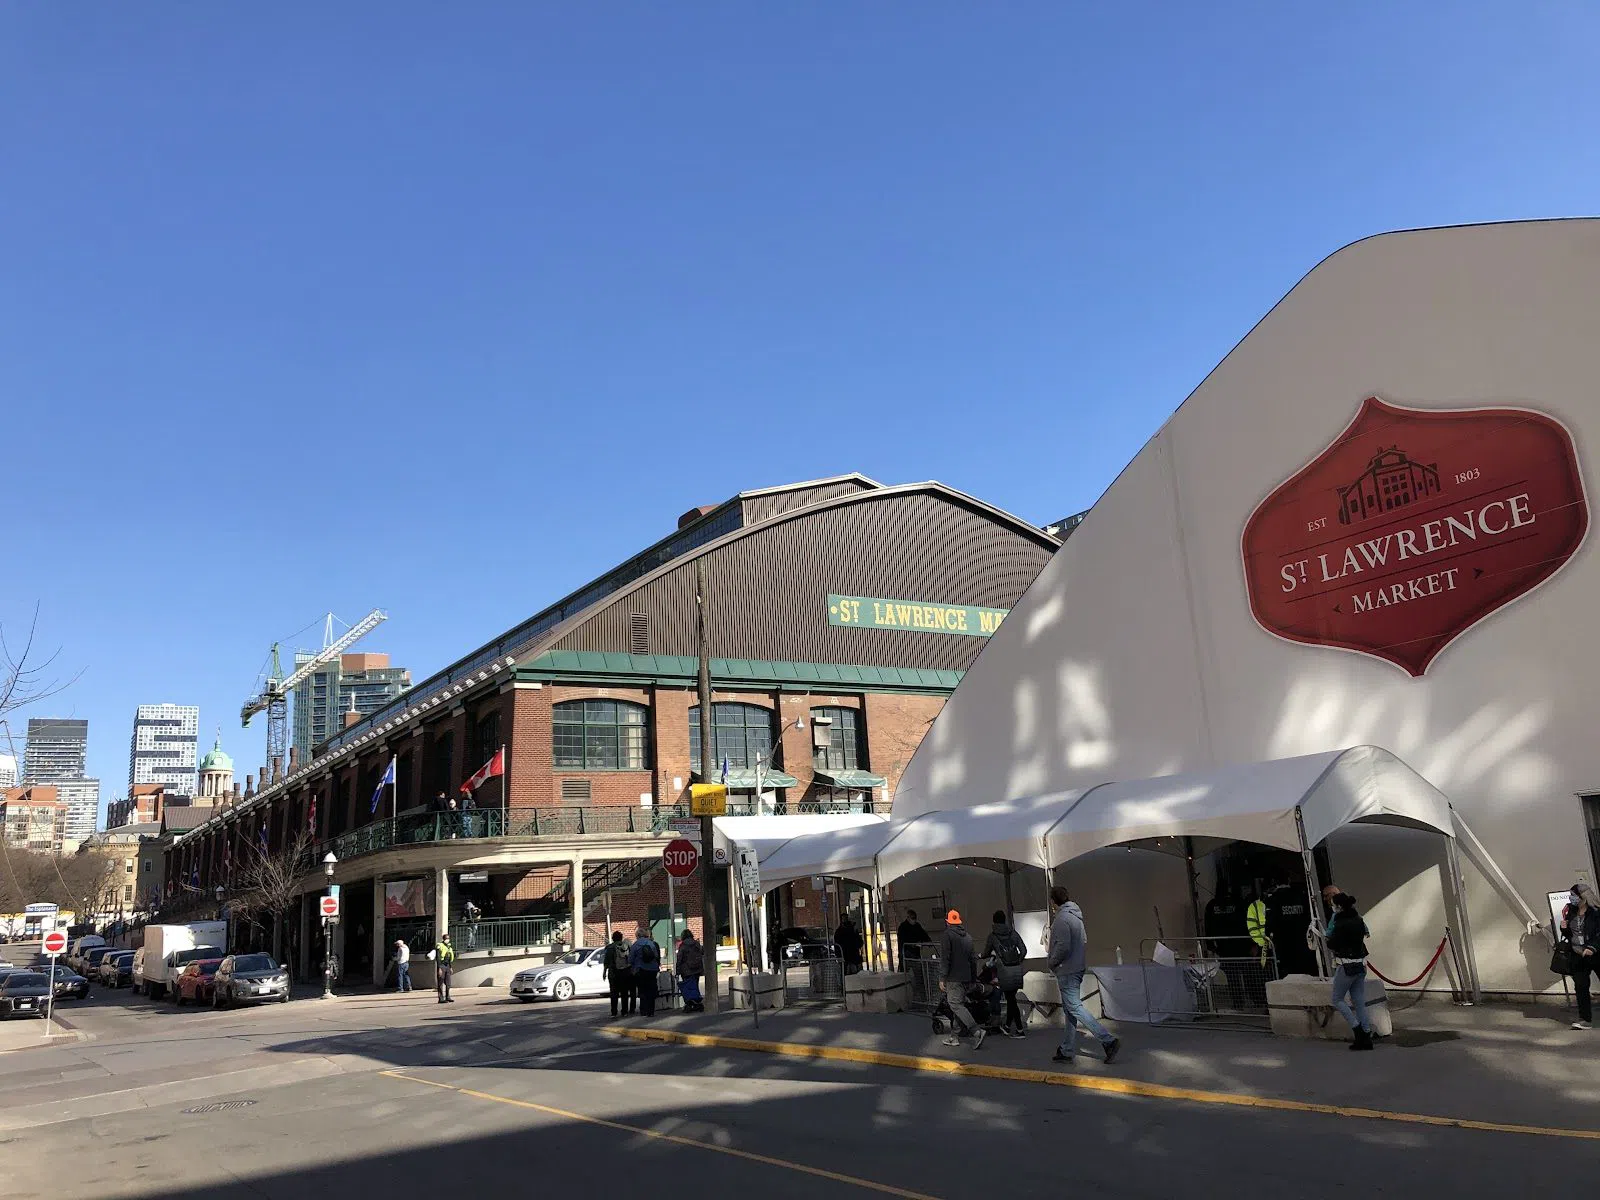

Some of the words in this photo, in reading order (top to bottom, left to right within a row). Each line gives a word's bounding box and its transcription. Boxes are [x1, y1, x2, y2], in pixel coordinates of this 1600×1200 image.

[1307, 517, 1327, 532] EST
[1454, 467, 1481, 485] 1803
[1317, 492, 1537, 582] LAWRENCE
[1351, 568, 1460, 615] MARKET
[873, 602, 968, 631] LAWRENCE
[978, 611, 1008, 633] MA
[700, 798, 717, 807] QUIET
[665, 850, 696, 866] STOP
